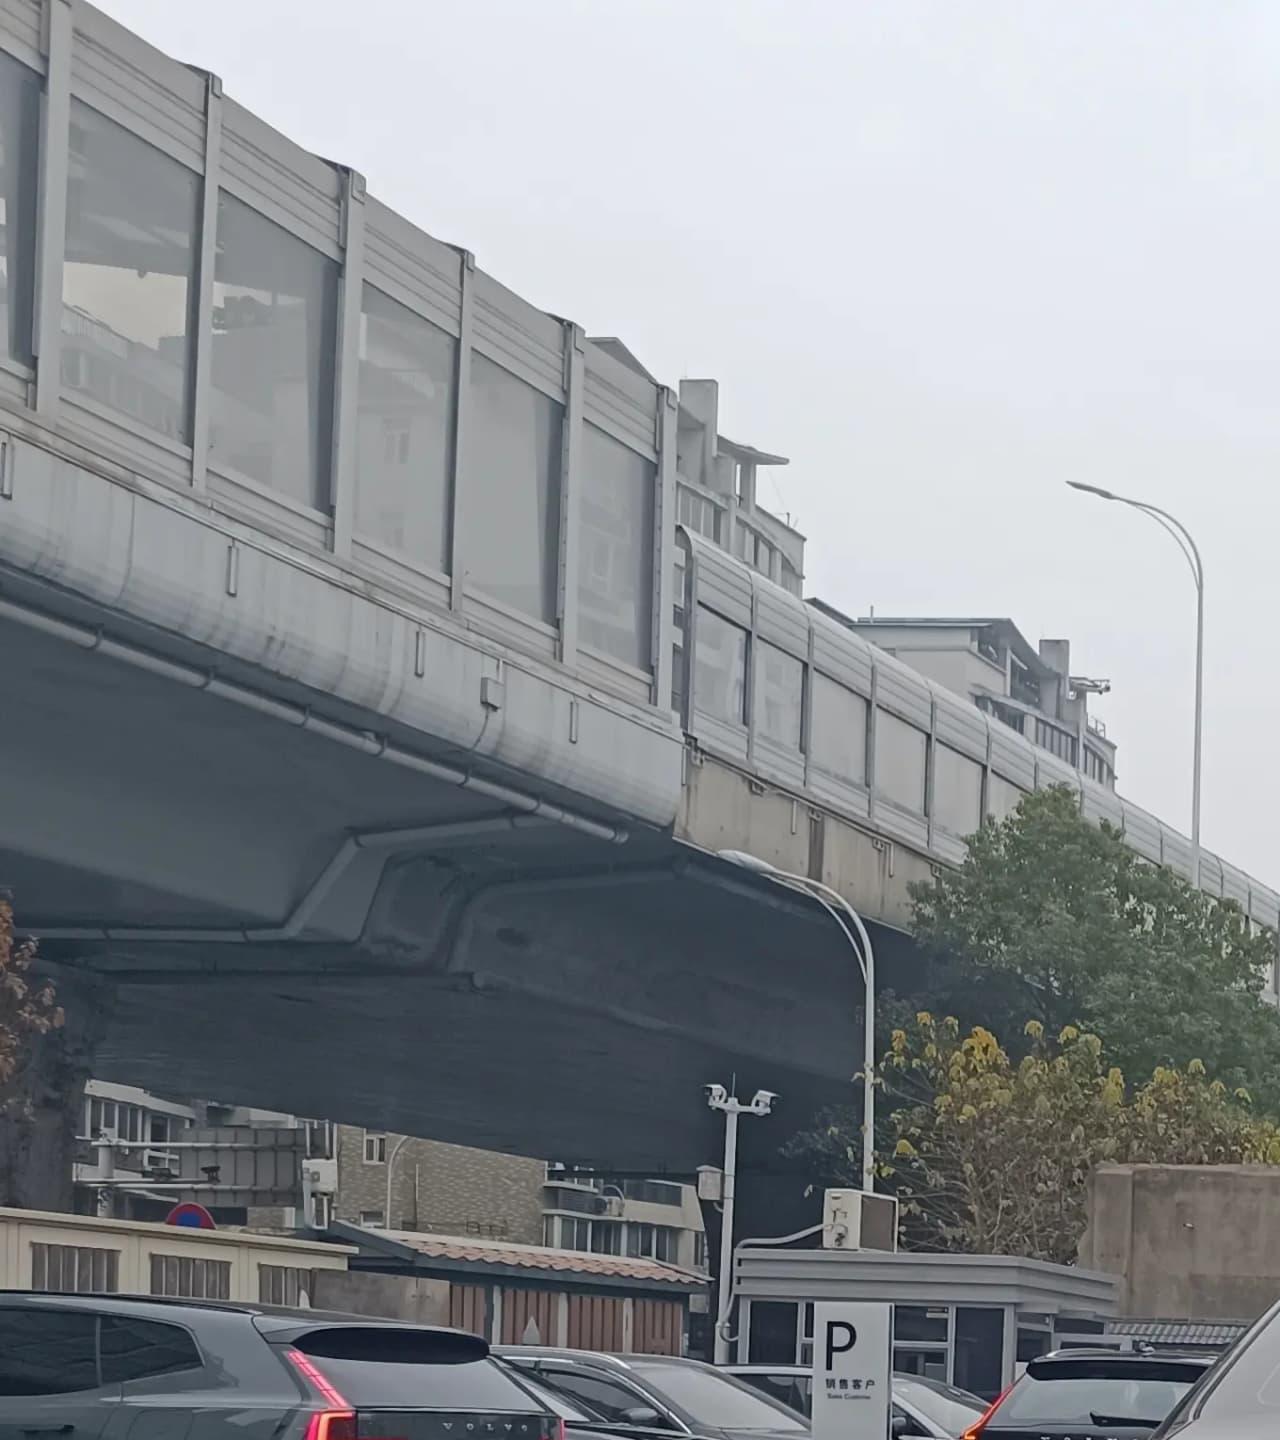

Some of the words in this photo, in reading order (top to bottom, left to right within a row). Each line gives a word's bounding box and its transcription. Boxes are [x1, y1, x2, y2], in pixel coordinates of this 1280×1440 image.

[826, 1321, 857, 1371] P
[825, 1378, 875, 1390] 销售客户
[443, 1422, 528, 1432] VOLVO
